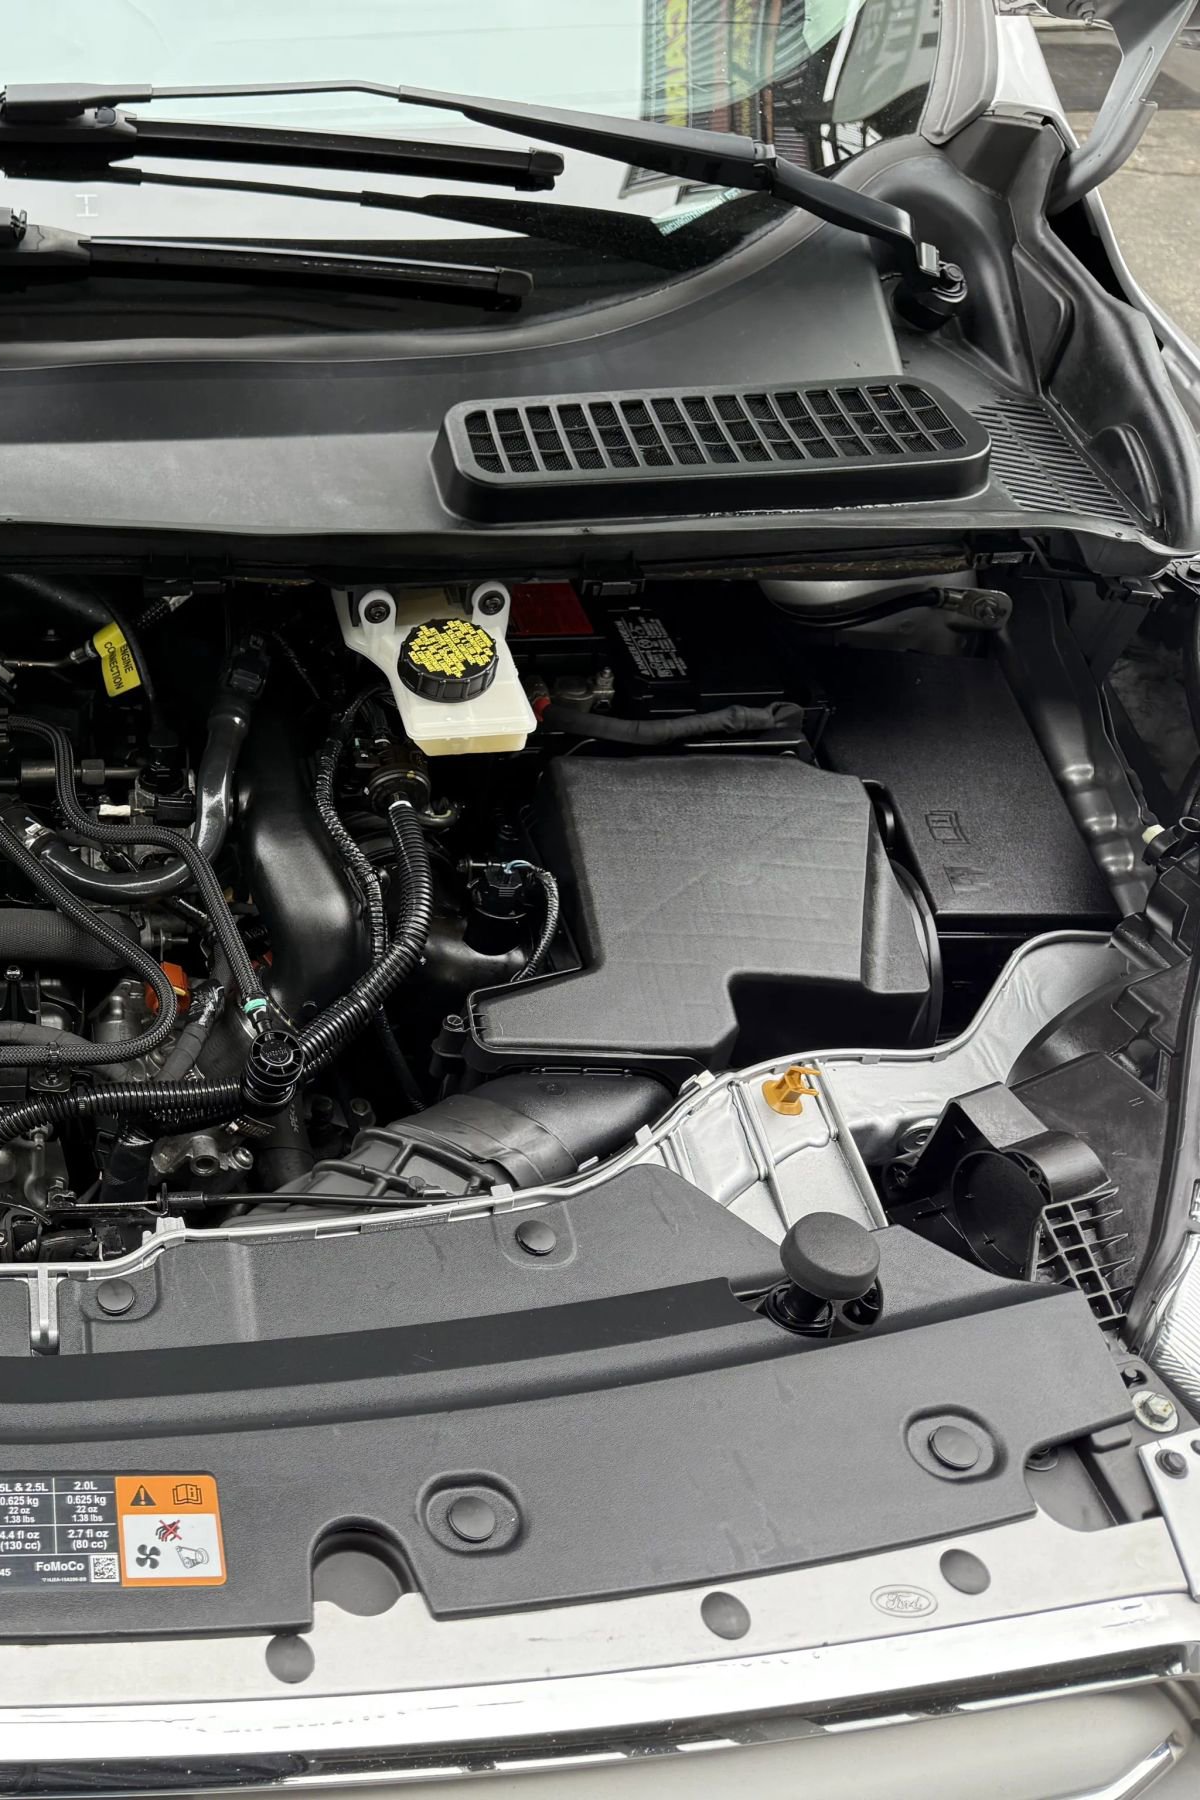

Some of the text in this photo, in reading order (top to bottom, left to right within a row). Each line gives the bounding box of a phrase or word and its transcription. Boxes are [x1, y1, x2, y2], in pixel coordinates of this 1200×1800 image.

[120, 643, 134, 674] ENGINE
[104, 641, 125, 690] CONNECTION
[14, 1483, 23, 1492] &
[25, 1482, 49, 1492] 2.5L
[73, 1481, 98, 1491] 2.0L
[0, 1496, 40, 1507] 0.625 kg
[67, 1494, 107, 1506] 0.625 kg
[75, 1505, 86, 1513] 22
[4, 1515, 35, 1523] 1.38 lbs
[72, 1514, 103, 1522] 1.38 lbs
[16, 1530, 25, 1539] fl
[26, 1531, 40, 1539] oz
[67, 1529, 109, 1539] 2.7 fl oz
[0, 1541, 41, 1552] (130 cc)
[72, 1540, 107, 1551] (80 cc)
[35, 1561, 85, 1572] FoMoCo
